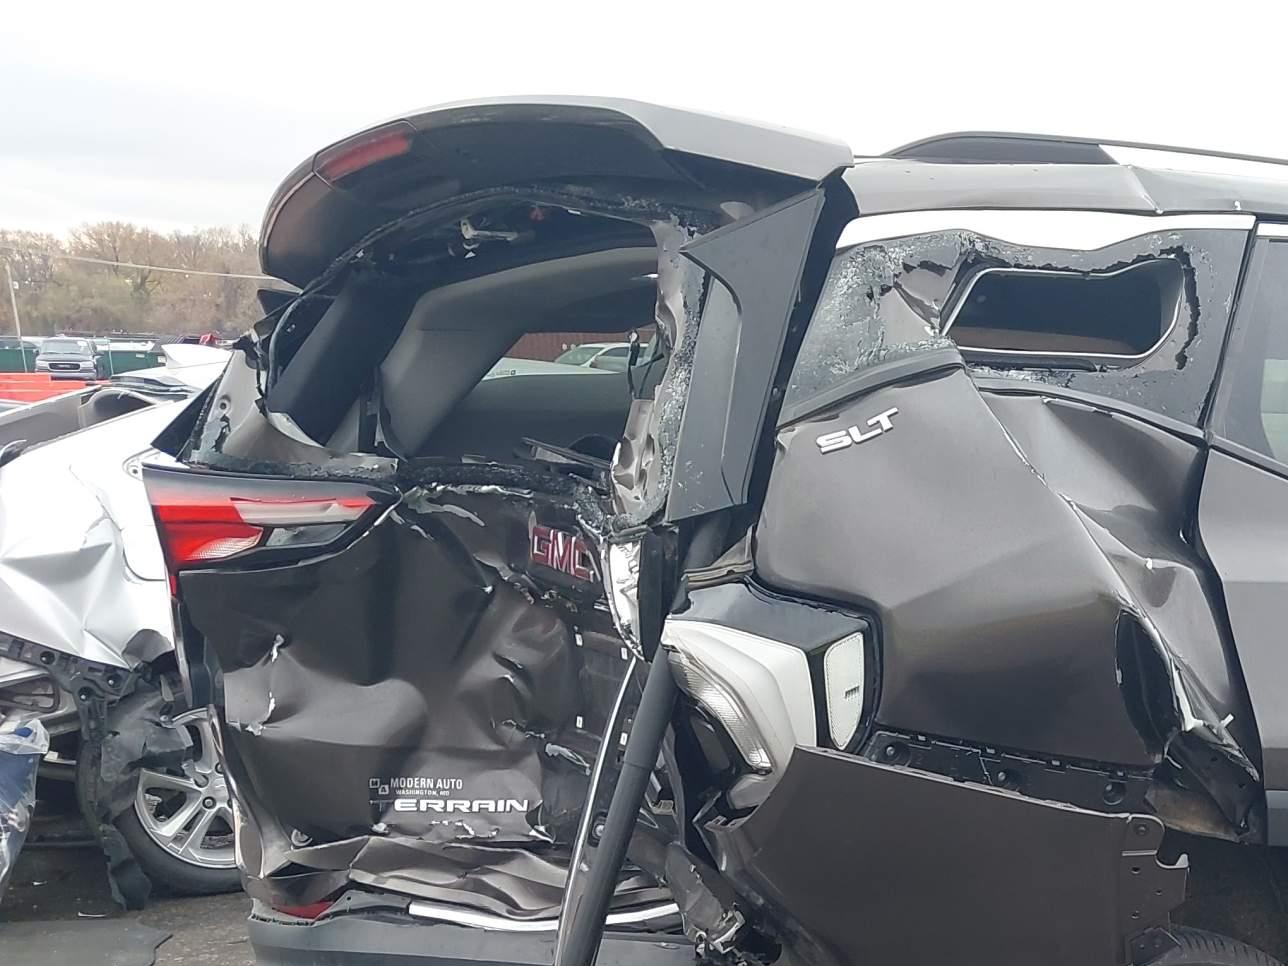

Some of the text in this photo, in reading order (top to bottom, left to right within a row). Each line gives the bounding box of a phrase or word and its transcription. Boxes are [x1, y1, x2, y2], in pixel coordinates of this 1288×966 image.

[816, 407, 898, 455] SLT
[533, 527, 594, 582] GMC
[390, 777, 434, 789] MODERN
[436, 778, 463, 790] AUTO
